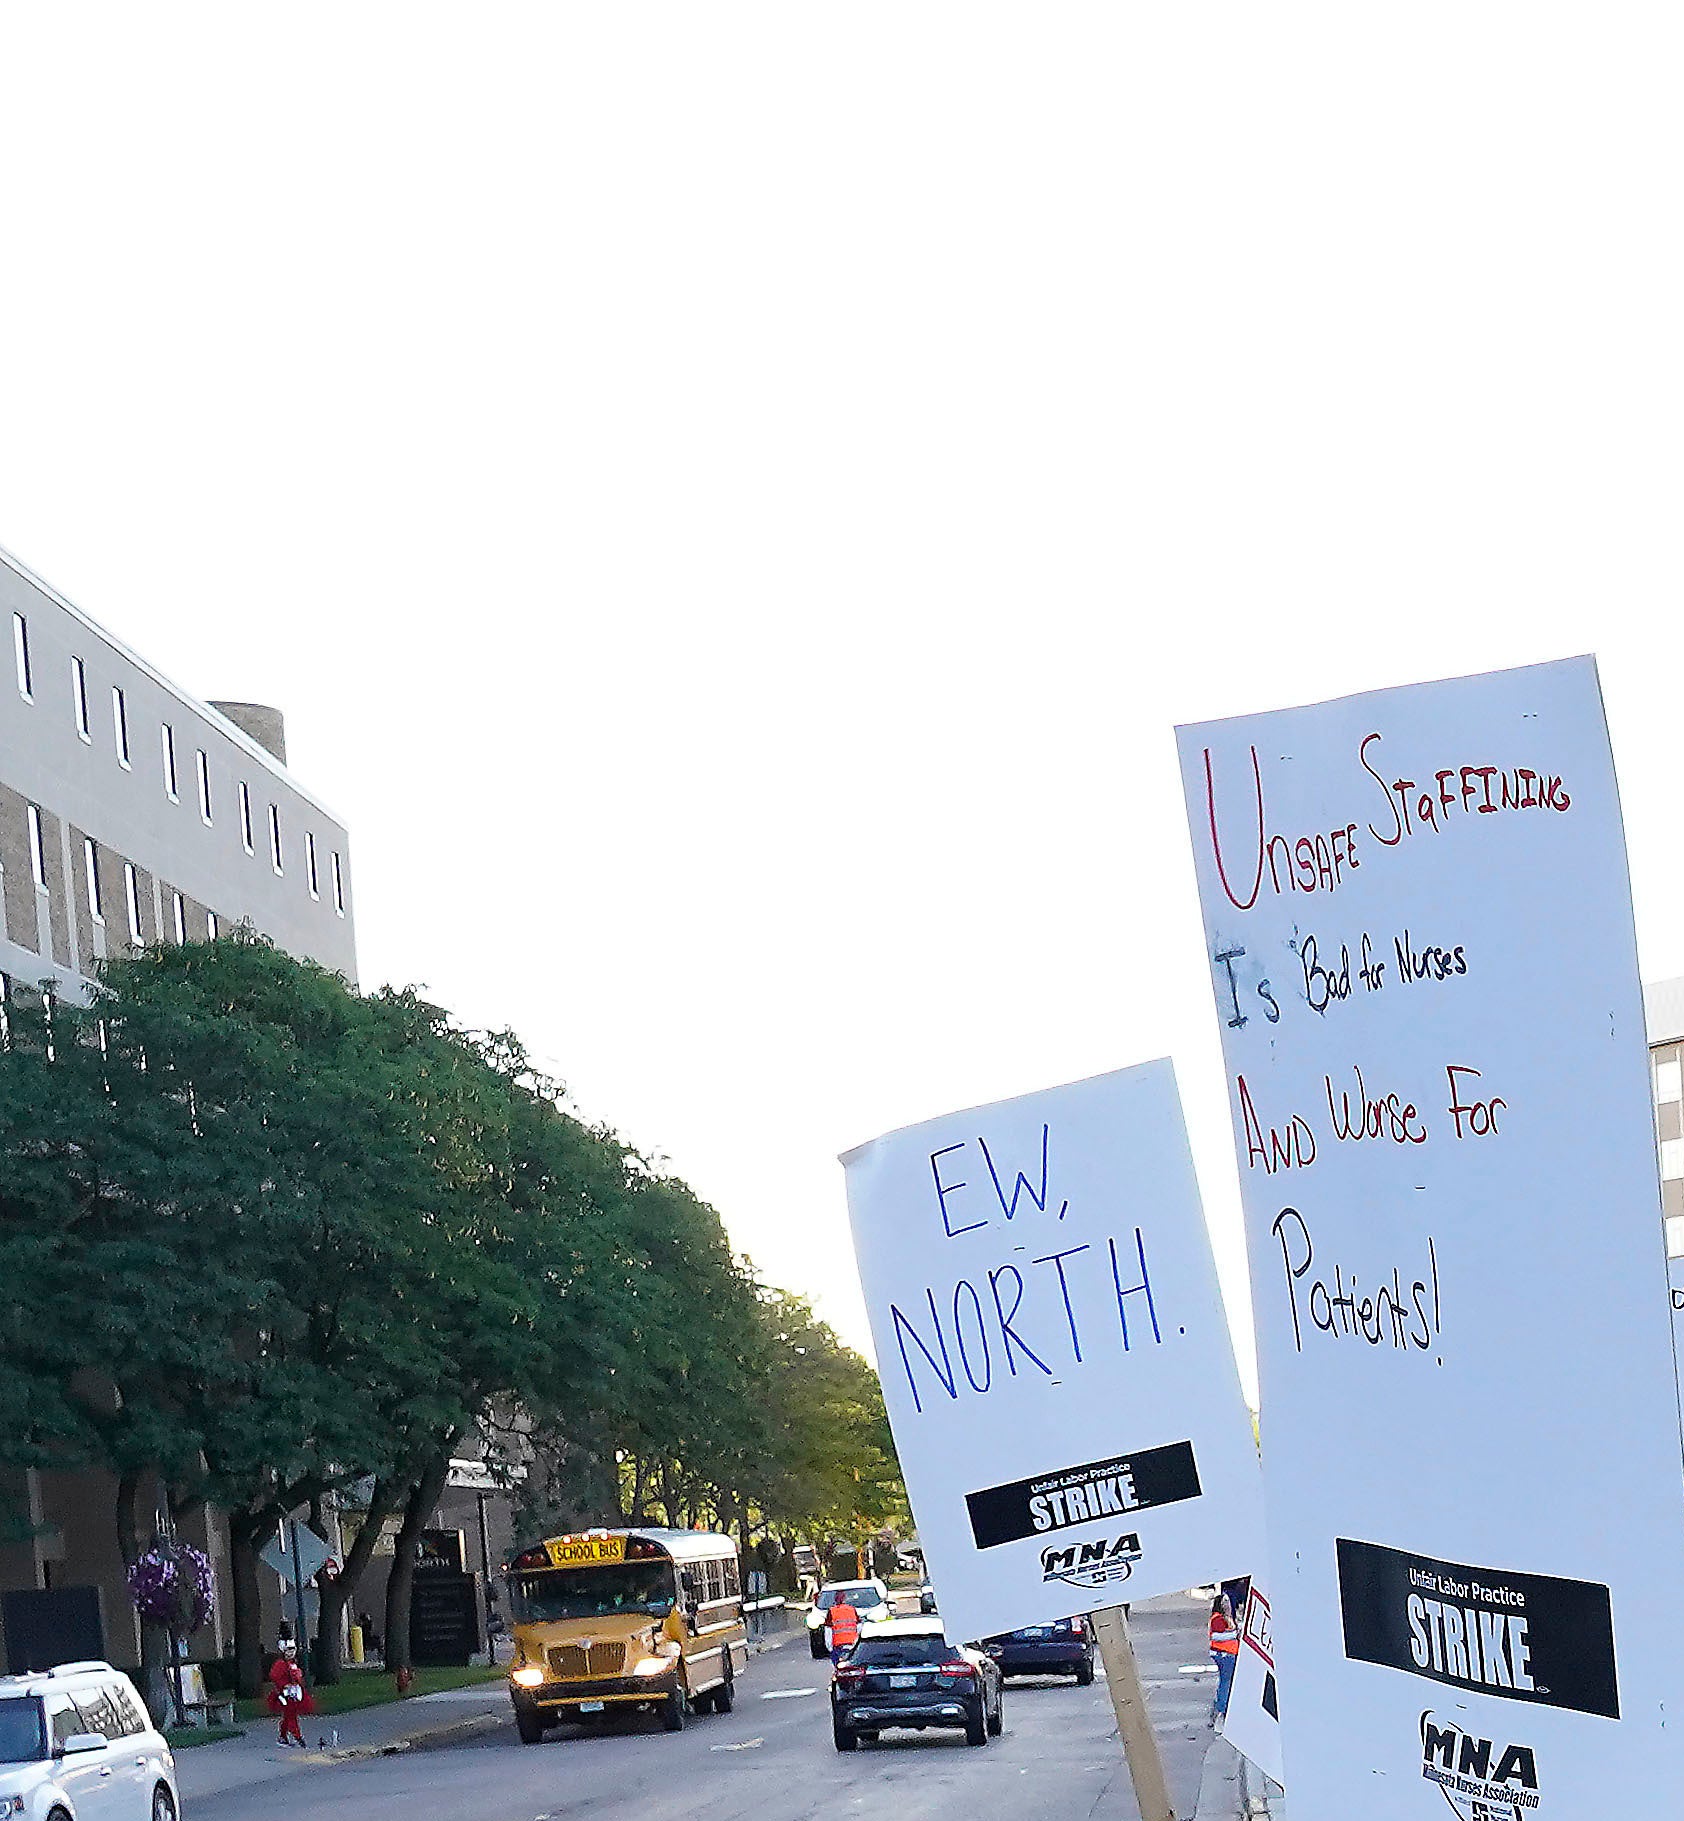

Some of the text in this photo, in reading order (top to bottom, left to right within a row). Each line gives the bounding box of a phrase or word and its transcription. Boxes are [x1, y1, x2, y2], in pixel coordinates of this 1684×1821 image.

[1395, 929, 1467, 984] Nurses
[1324, 1065, 1427, 1144] Worse
[1447, 1065, 1508, 1140] For
[930, 1123, 1068, 1238] EW,
[1272, 1207, 1443, 1366] Patients!
[890, 1227, 1186, 1414] NORTH.
[1029, 1474, 1140, 1531] STRIKE
[1060, 1472, 1089, 1486] Labor
[1090, 1463, 1131, 1479] Practice
[557, 1541, 619, 1561] SCHOOL BUS
[1044, 1533, 1141, 1573] MNA
[1409, 1567, 1526, 1607] Unfair Labor Practice
[1406, 1593, 1536, 1692] STRIKE
[1423, 1723, 1538, 1790] MNA
